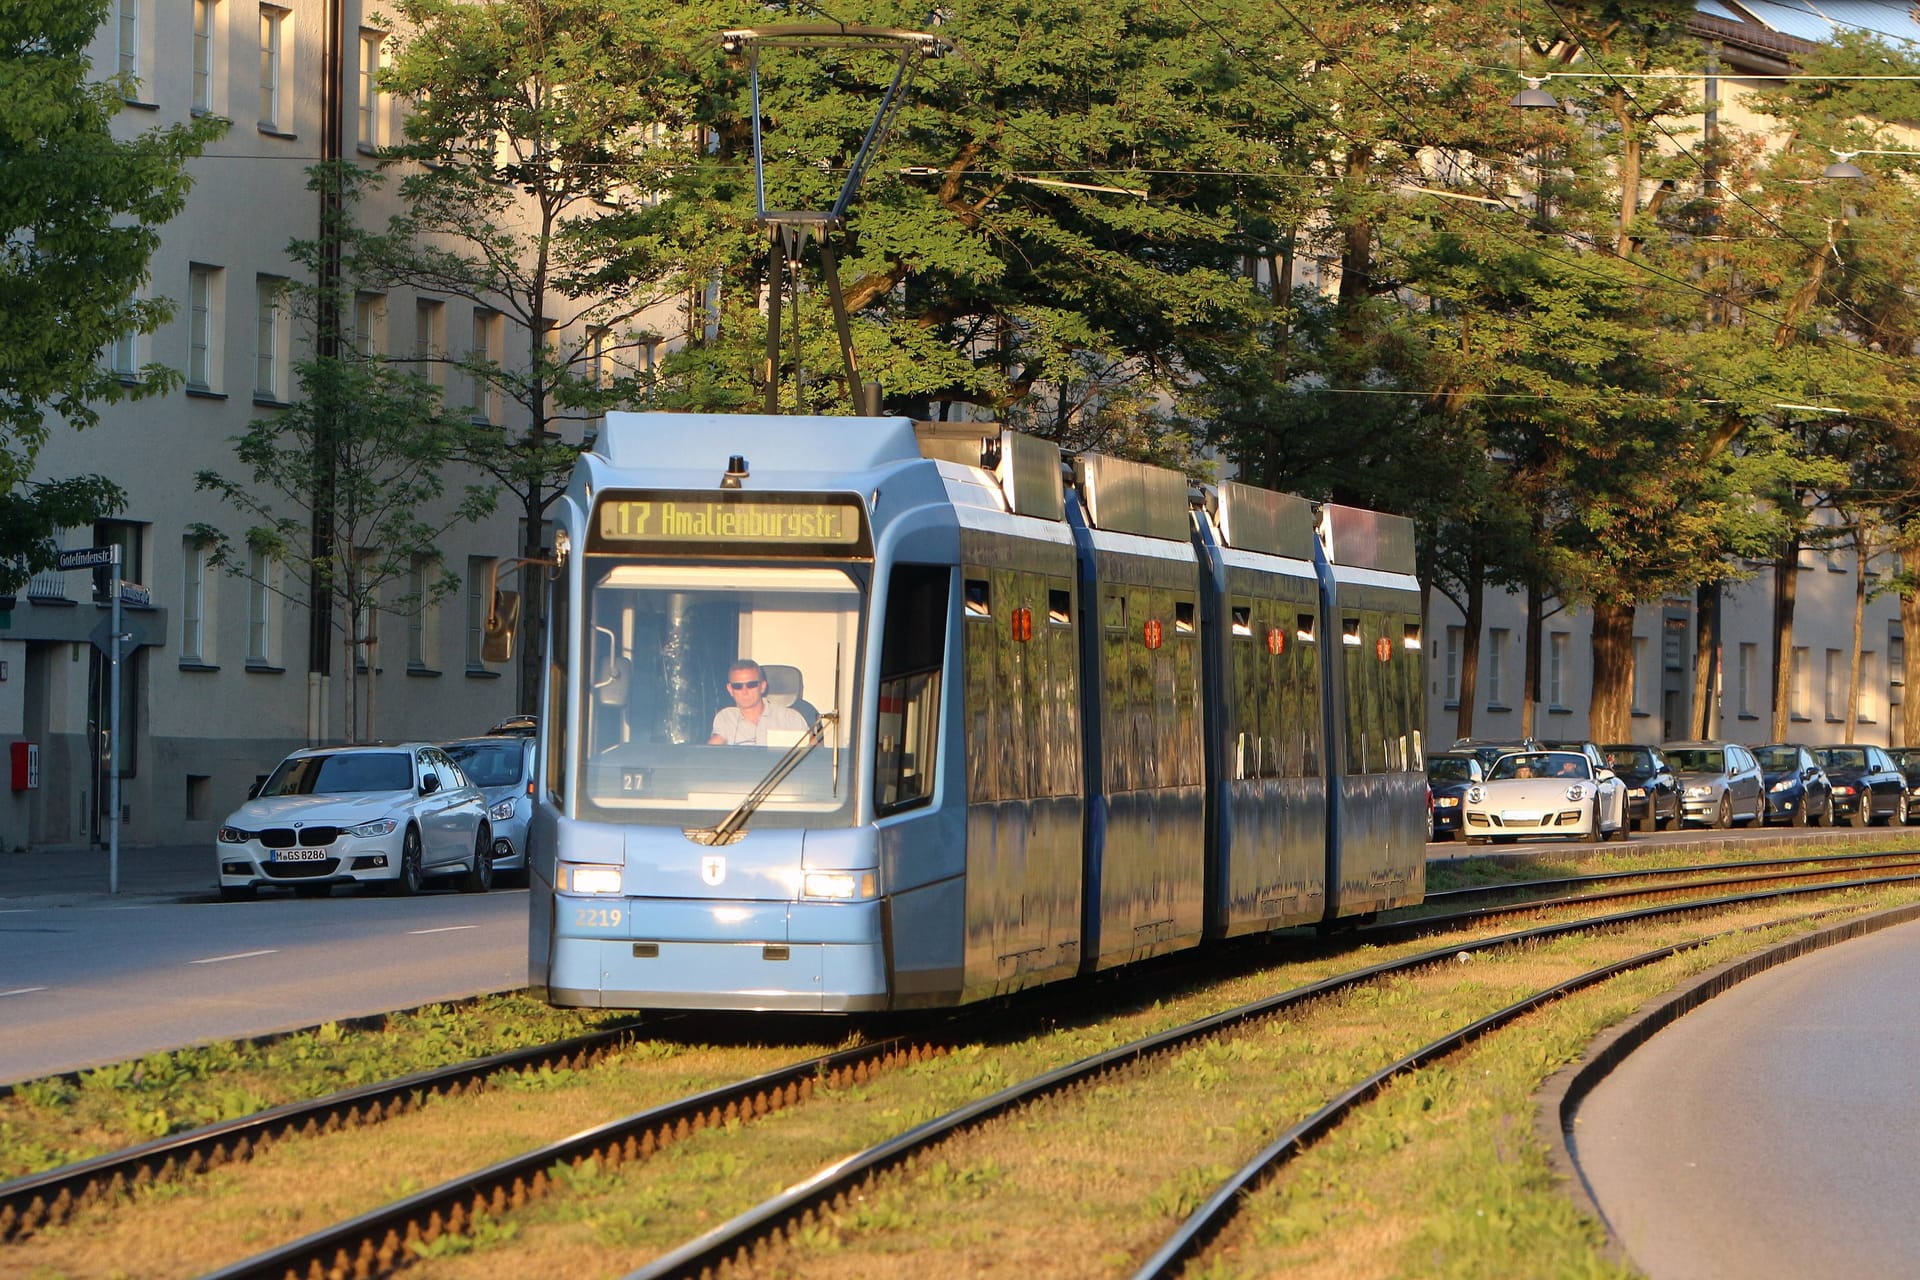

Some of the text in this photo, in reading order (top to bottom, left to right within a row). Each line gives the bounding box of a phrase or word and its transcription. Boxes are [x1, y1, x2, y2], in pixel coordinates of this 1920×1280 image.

[617, 501, 842, 537] 17 Amalienburgstr.
[623, 775, 642, 790] 27
[575, 909, 622, 927] 2219
